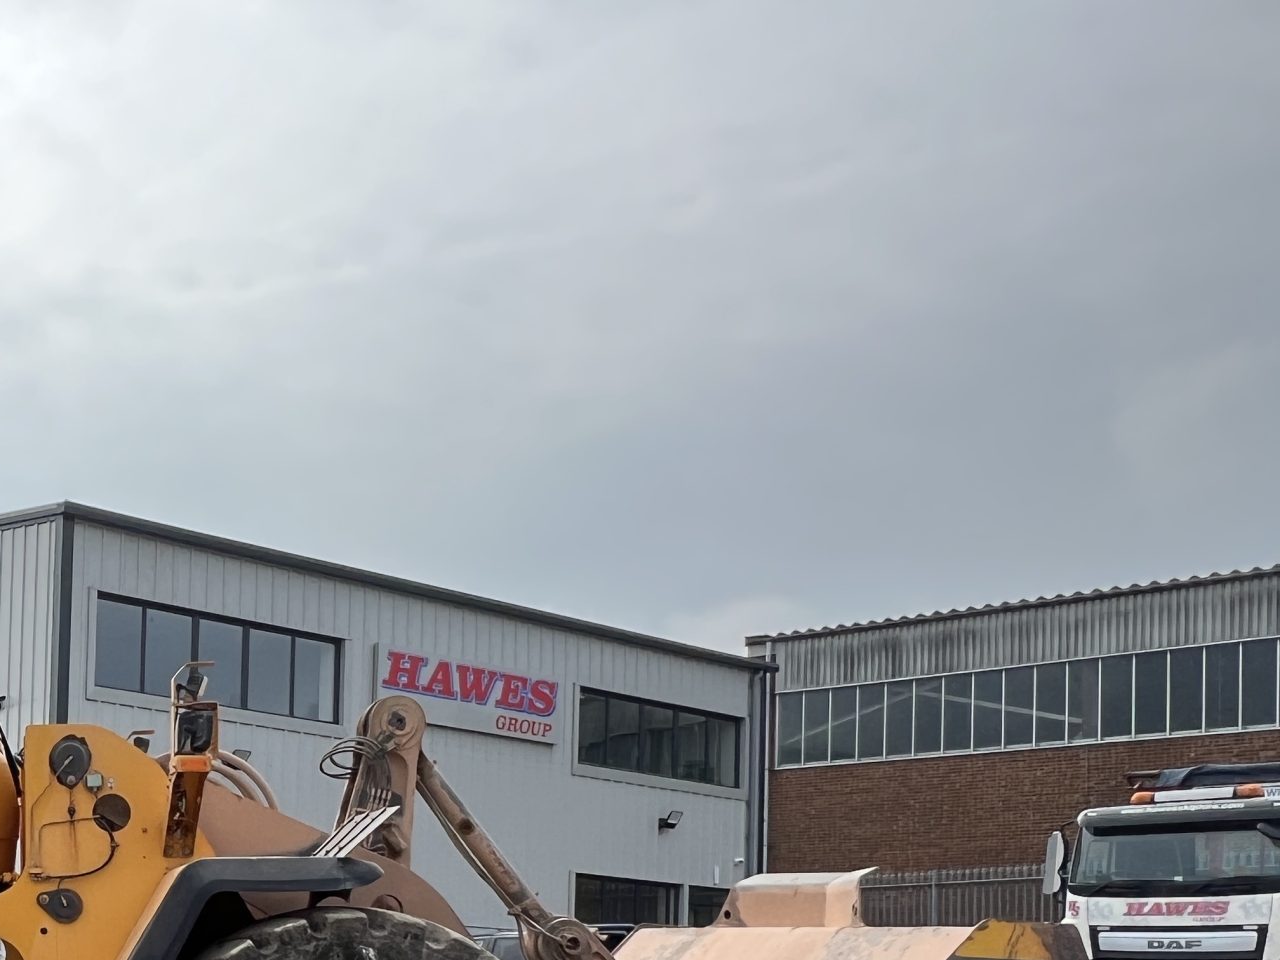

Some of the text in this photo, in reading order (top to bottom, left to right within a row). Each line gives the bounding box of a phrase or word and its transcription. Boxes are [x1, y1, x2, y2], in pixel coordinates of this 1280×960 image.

[381, 650, 558, 716] HAWES
[496, 715, 552, 737] GROUP
[1123, 901, 1230, 917] HAWES
[1147, 940, 1203, 950] DAF
